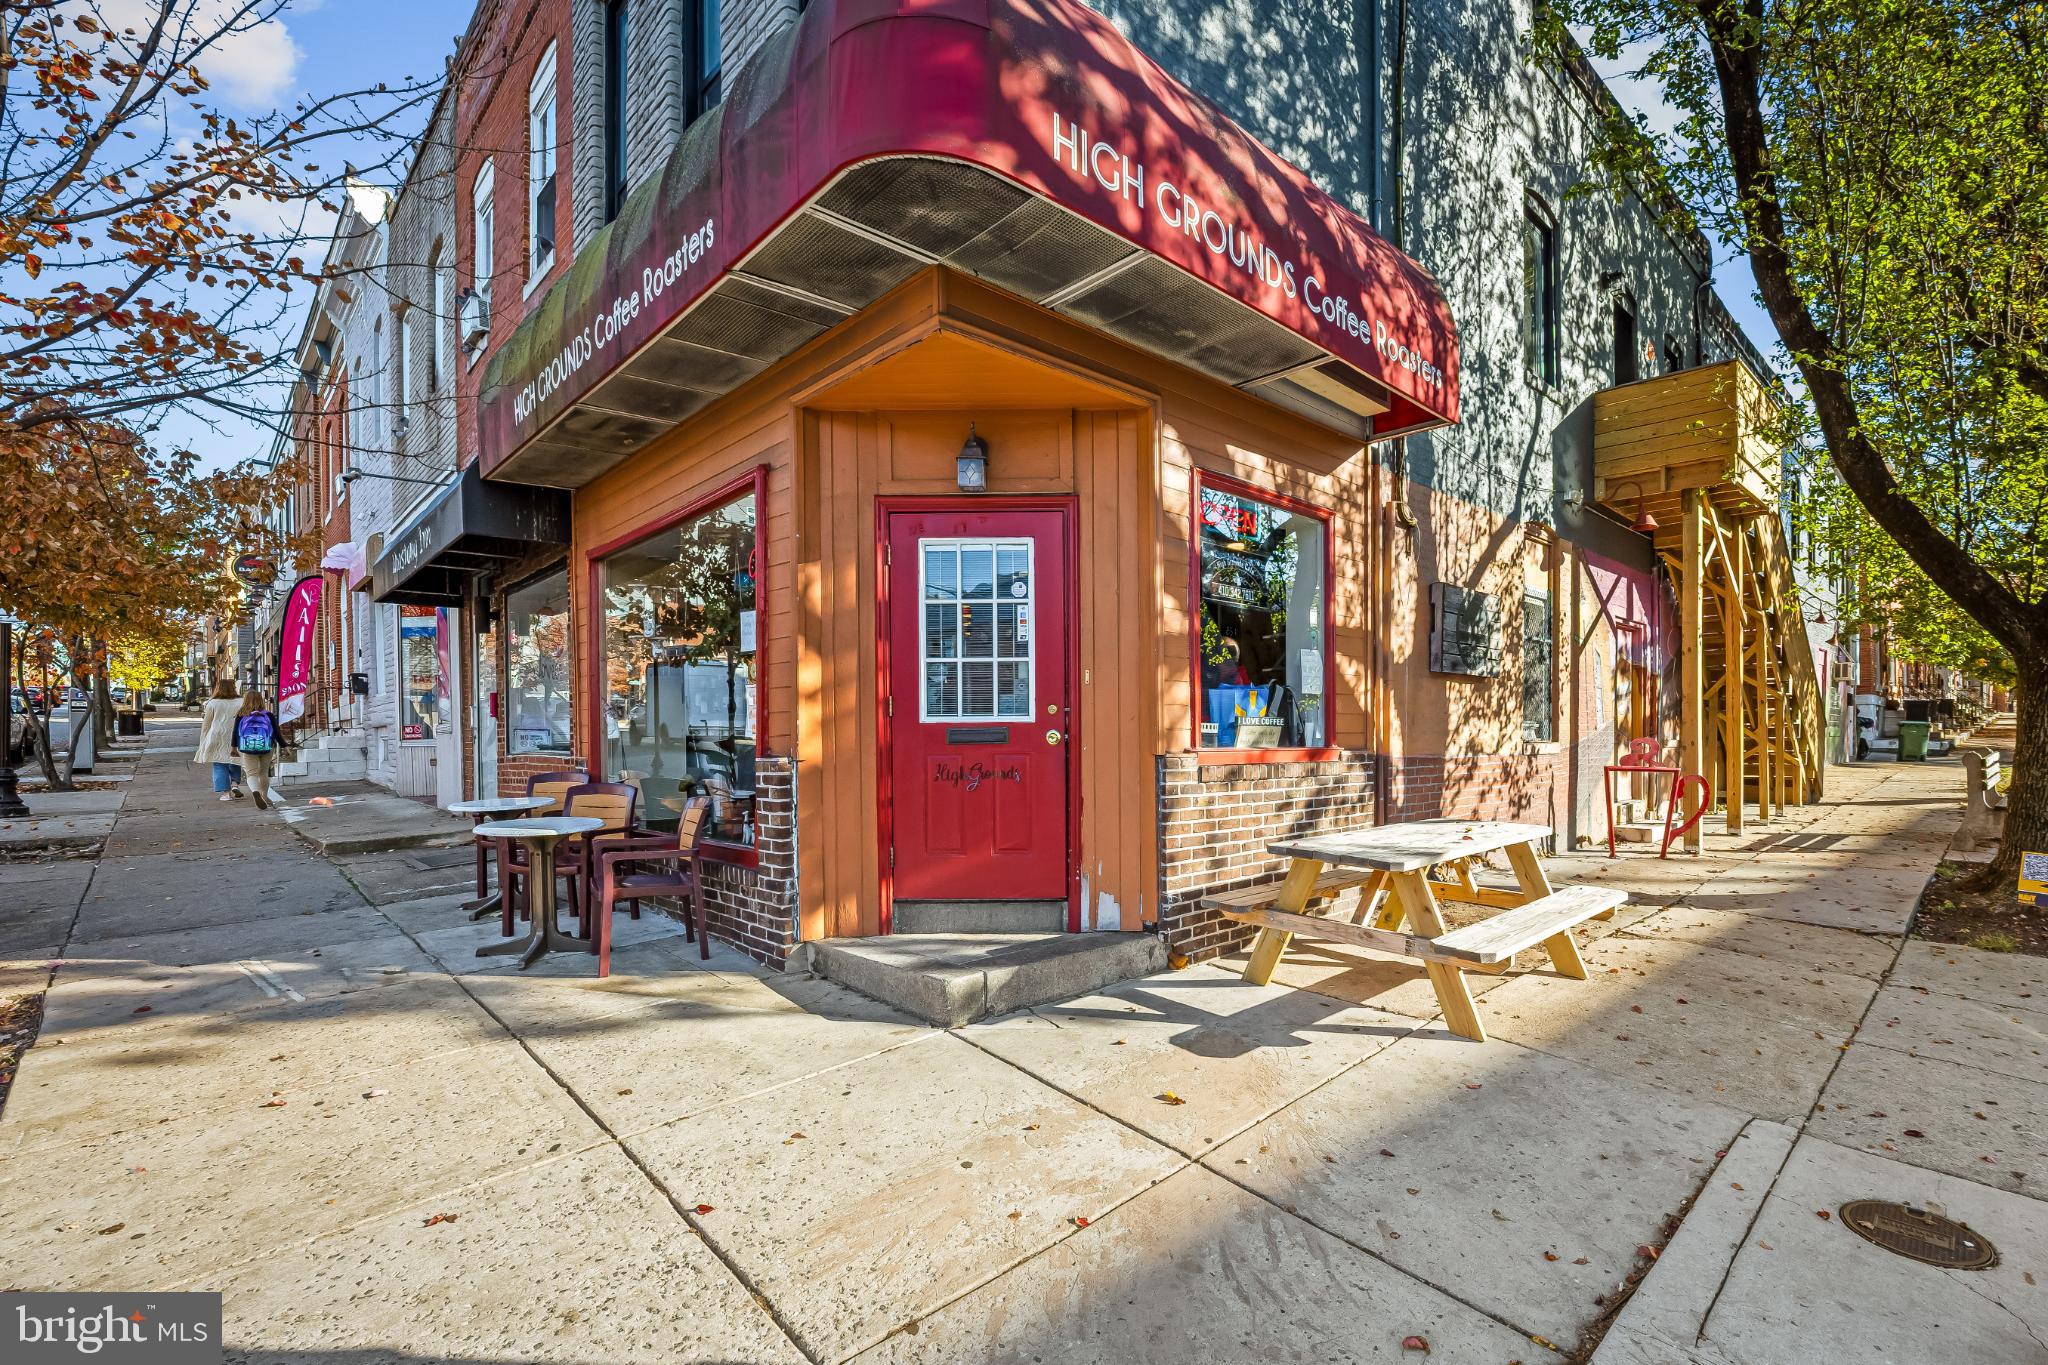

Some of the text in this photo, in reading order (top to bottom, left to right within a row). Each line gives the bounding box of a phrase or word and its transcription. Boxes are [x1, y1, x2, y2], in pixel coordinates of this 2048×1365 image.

[1052, 112, 1443, 390] HIGH GROUNDS Coffee Roasters
[513, 218, 715, 427] HIGH GROUNDS Coffee Roasters
[404, 726, 413, 734] NO
[1242, 717, 1260, 725] LOVE
[1261, 717, 1285, 726] COFFEE
